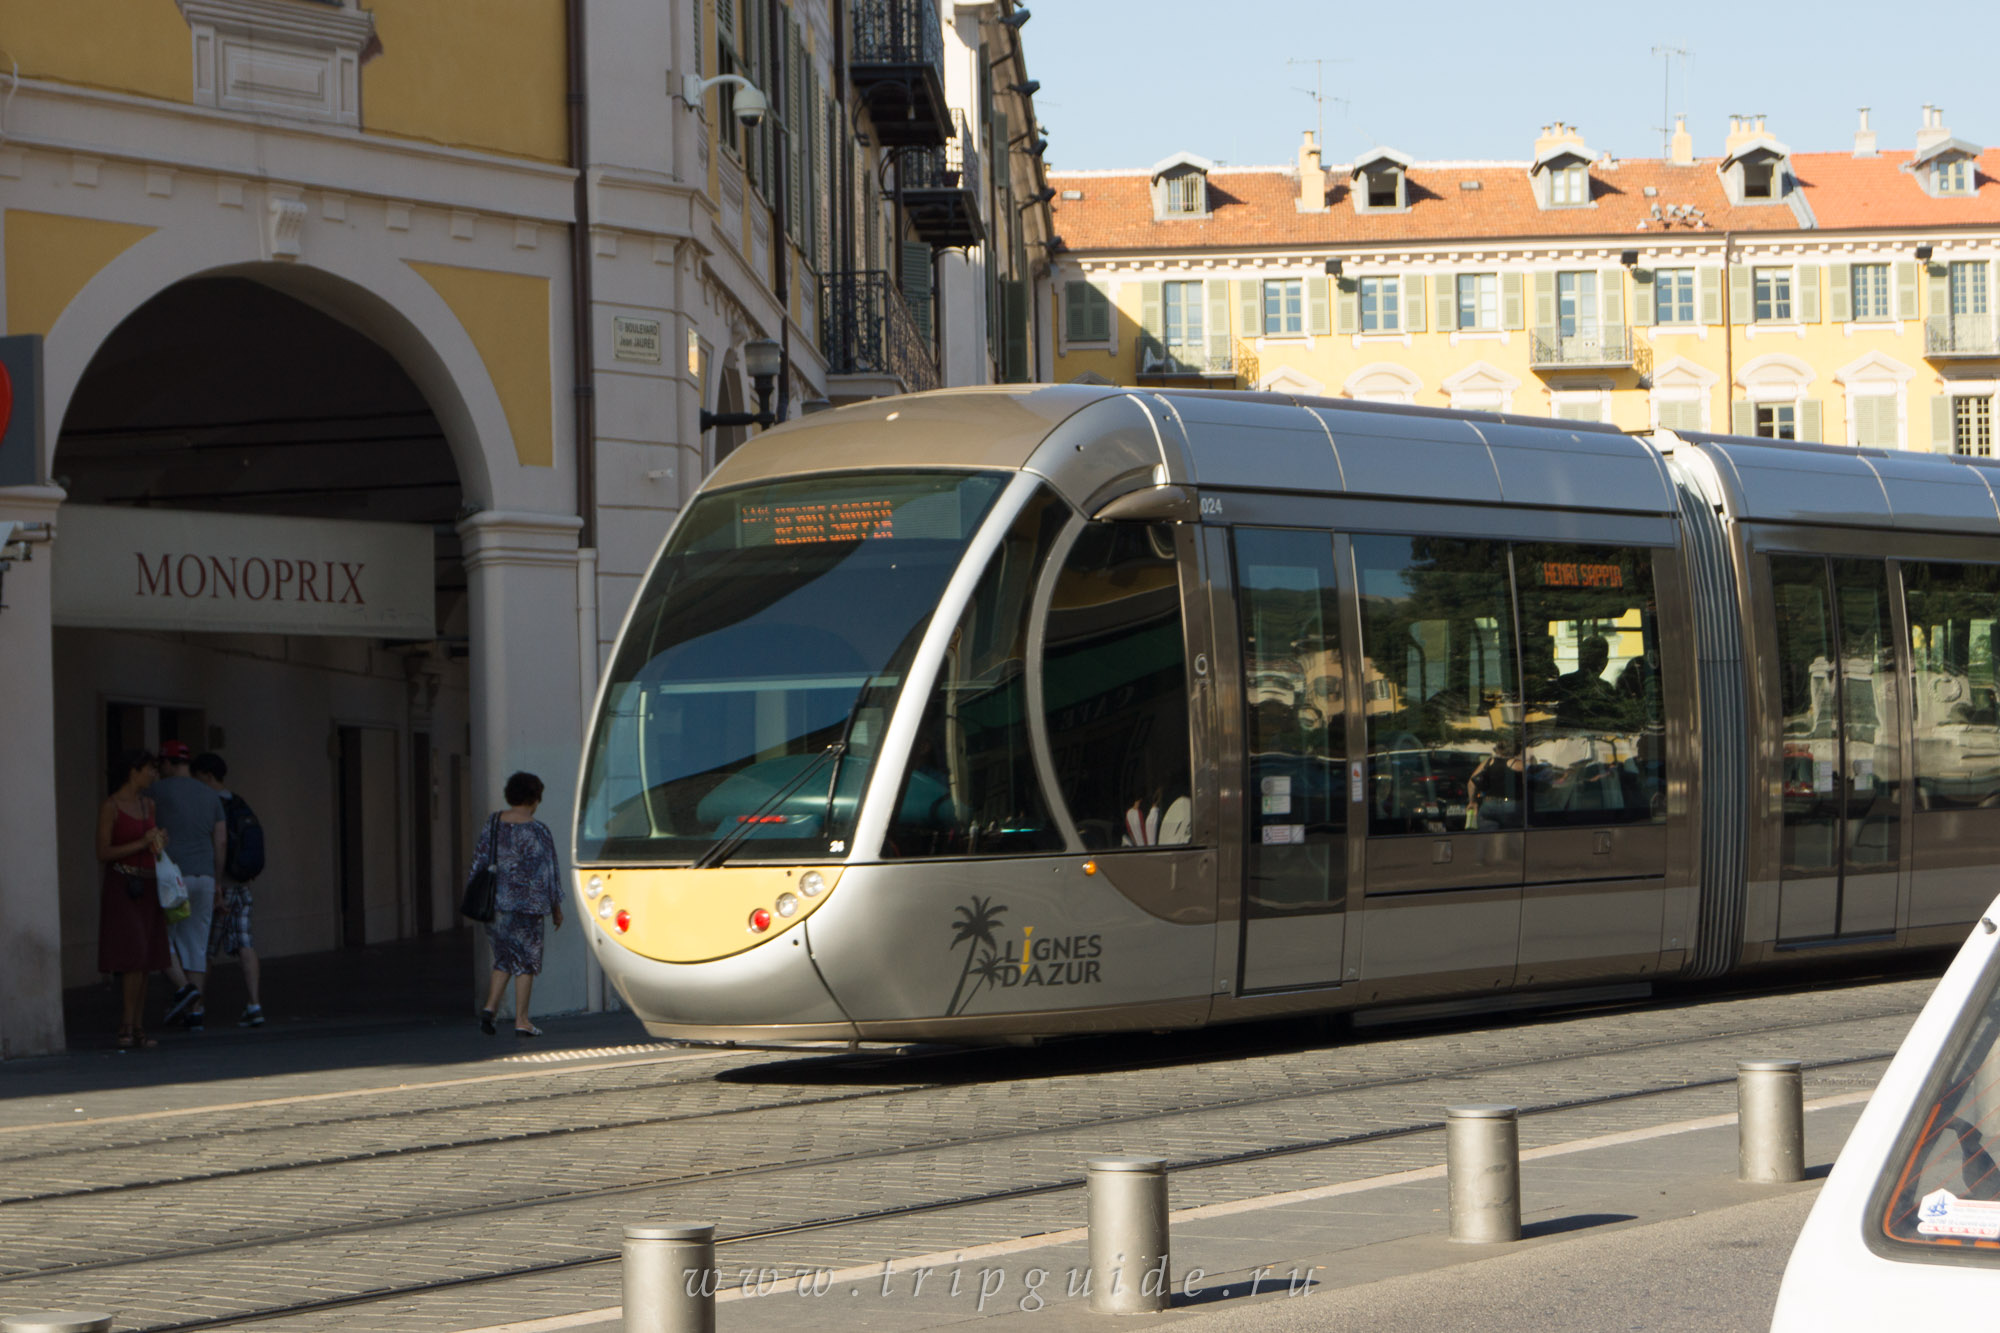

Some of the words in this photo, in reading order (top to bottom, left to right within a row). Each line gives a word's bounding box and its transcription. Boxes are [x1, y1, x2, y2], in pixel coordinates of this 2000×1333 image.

[625, 322, 657, 336] BOULEVARD
[1201, 497, 1223, 514] 024
[134, 552, 365, 604] MONOPRIX
[1543, 562, 1579, 585] HENRI
